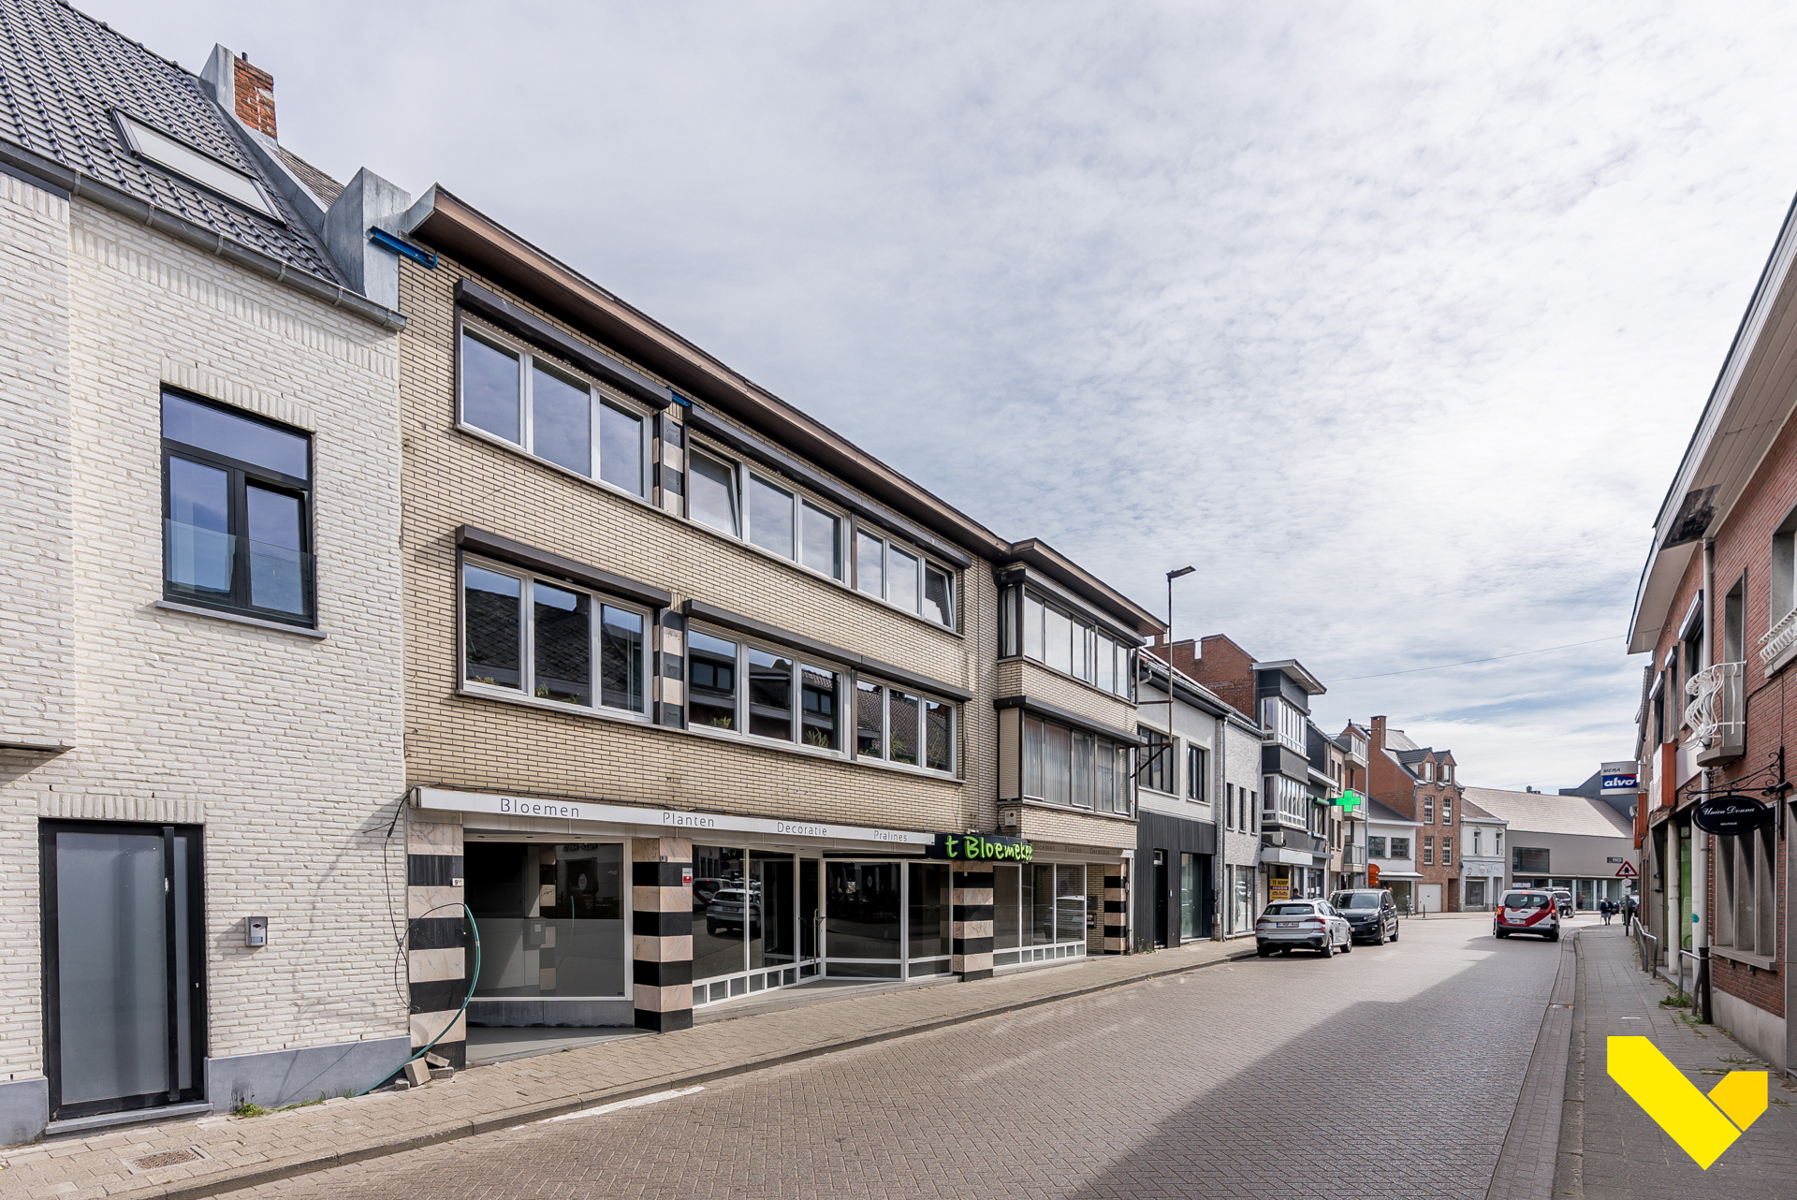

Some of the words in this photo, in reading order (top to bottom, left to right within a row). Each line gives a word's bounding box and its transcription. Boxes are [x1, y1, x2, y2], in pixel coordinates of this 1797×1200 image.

[500, 797, 580, 818] Bloemen
[662, 811, 716, 828] Planten
[777, 821, 828, 837] Decoratie
[873, 829, 908, 842] Pralines
[1726, 805, 1756, 815] Donna
